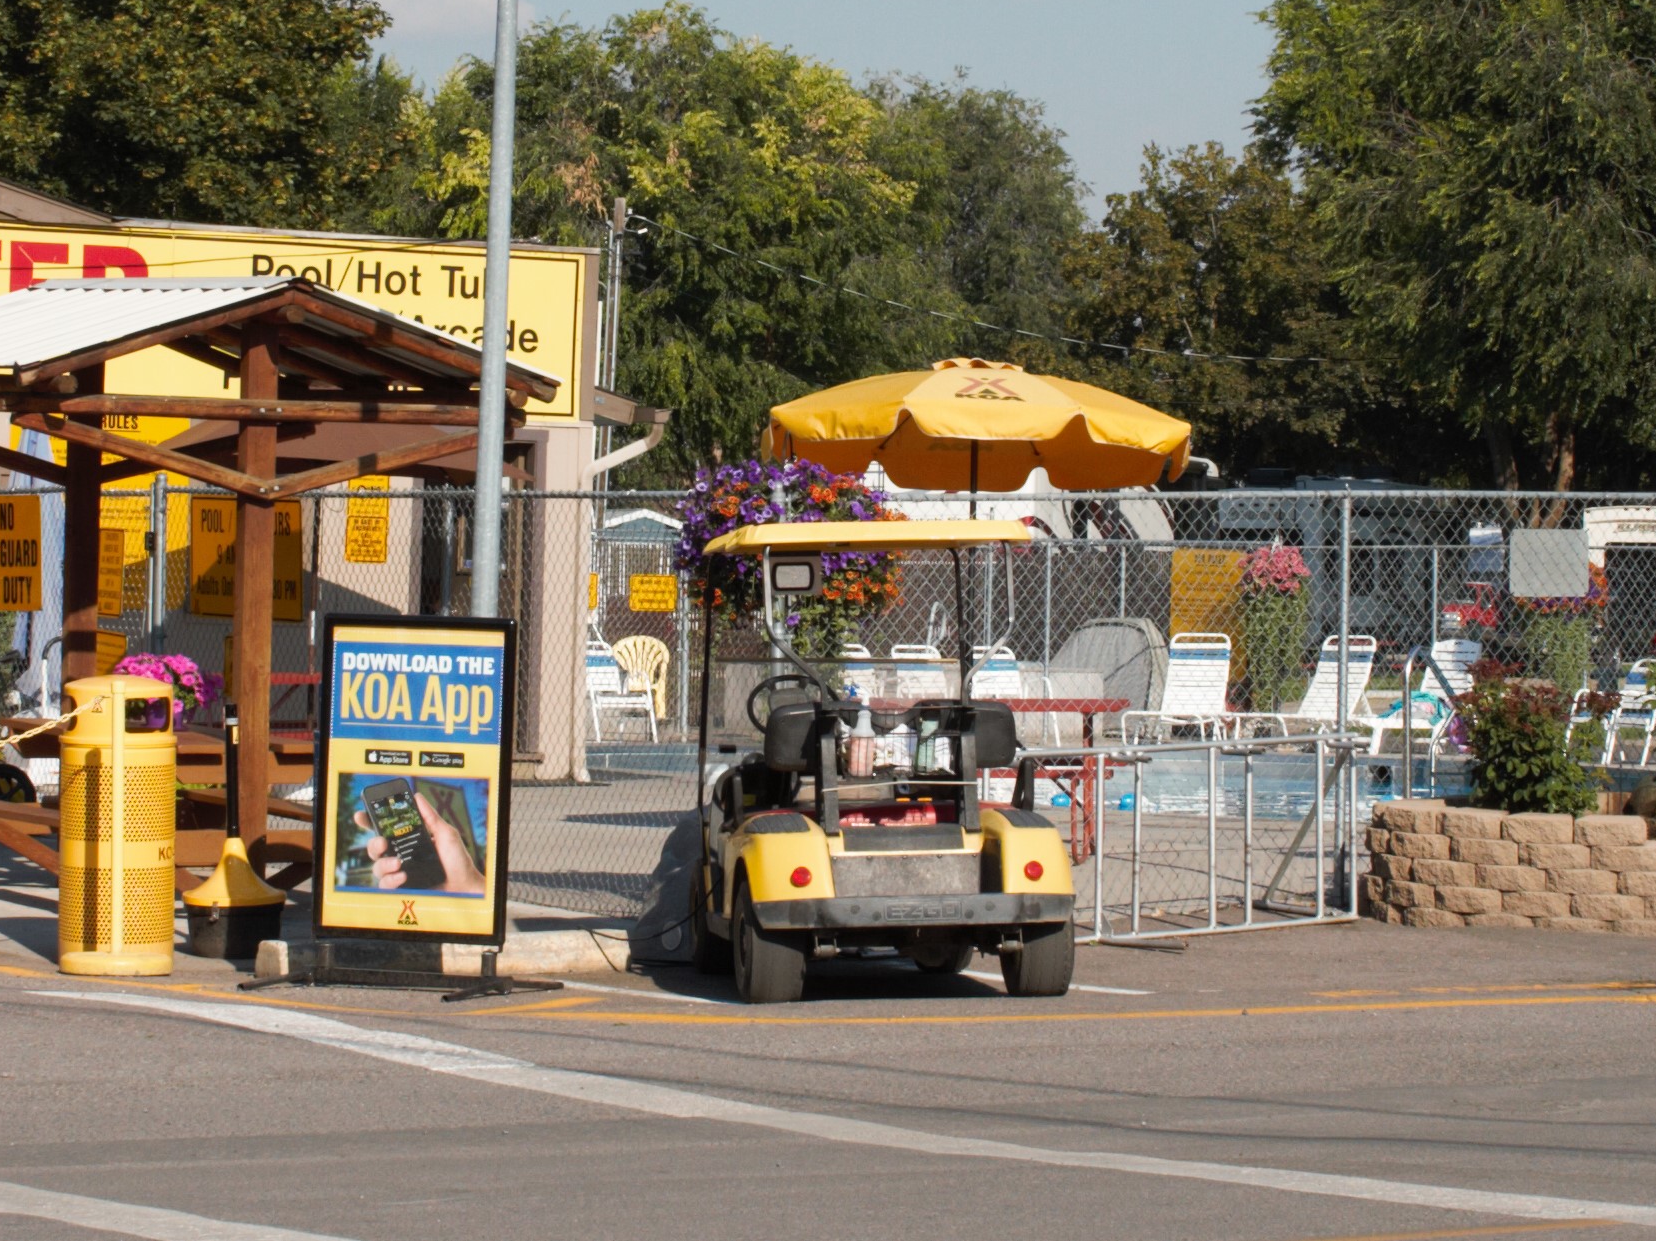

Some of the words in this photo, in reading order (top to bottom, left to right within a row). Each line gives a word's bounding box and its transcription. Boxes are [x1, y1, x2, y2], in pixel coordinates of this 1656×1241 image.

[440, 264, 486, 300] Tu
[954, 392, 1027, 402] KOA
[0, 502, 15, 531] NO
[201, 508, 225, 533] POOL
[3, 576, 33, 604] DUTY
[342, 651, 453, 675] DOWNLOAD
[457, 656, 495, 676] THE
[340, 672, 412, 721] KOA
[419, 674, 494, 736] App
[379, 756, 393, 764] App
[393, 756, 409, 764] Store
[158, 846, 175, 861] KO
[397, 919, 419, 927] KOA
